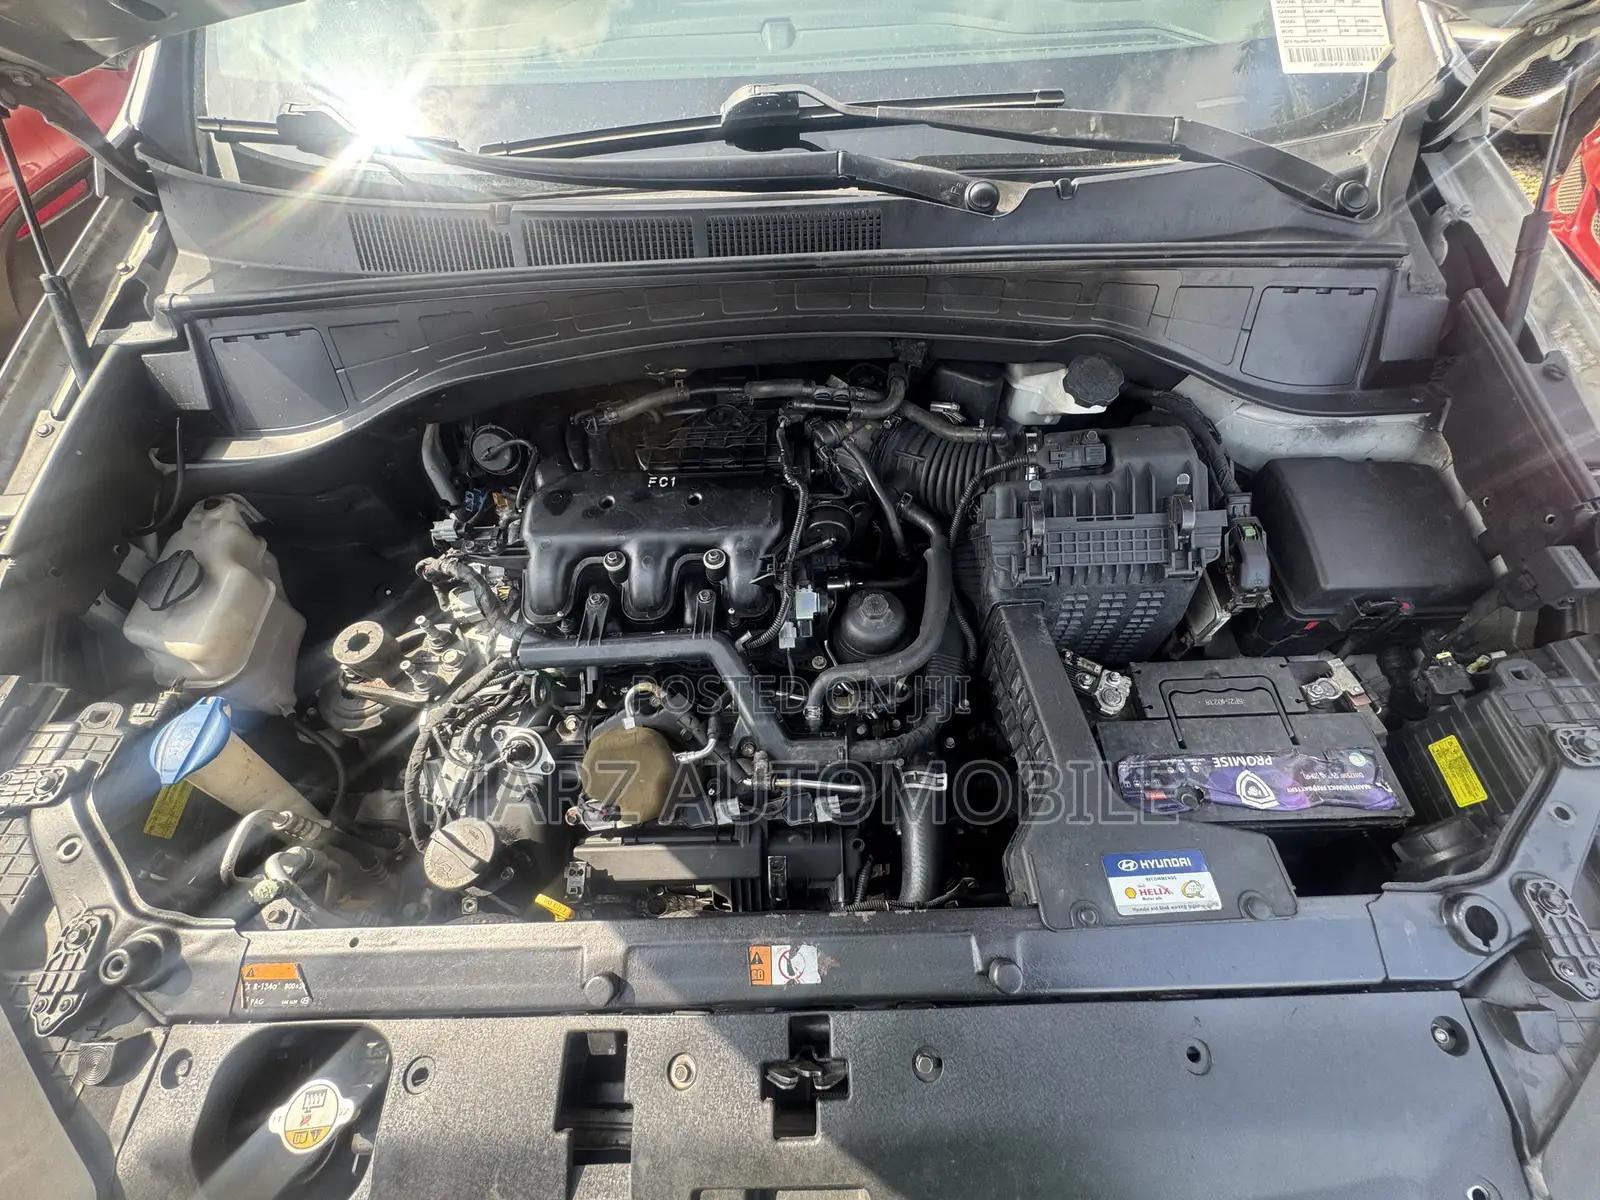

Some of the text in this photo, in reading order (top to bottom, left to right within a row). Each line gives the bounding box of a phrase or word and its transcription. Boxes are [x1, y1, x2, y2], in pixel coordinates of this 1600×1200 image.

[1211, 754, 1273, 769] PROMISE
[1139, 857, 1192, 870] HYUNDAI
[1138, 887, 1171, 897] HELIX
